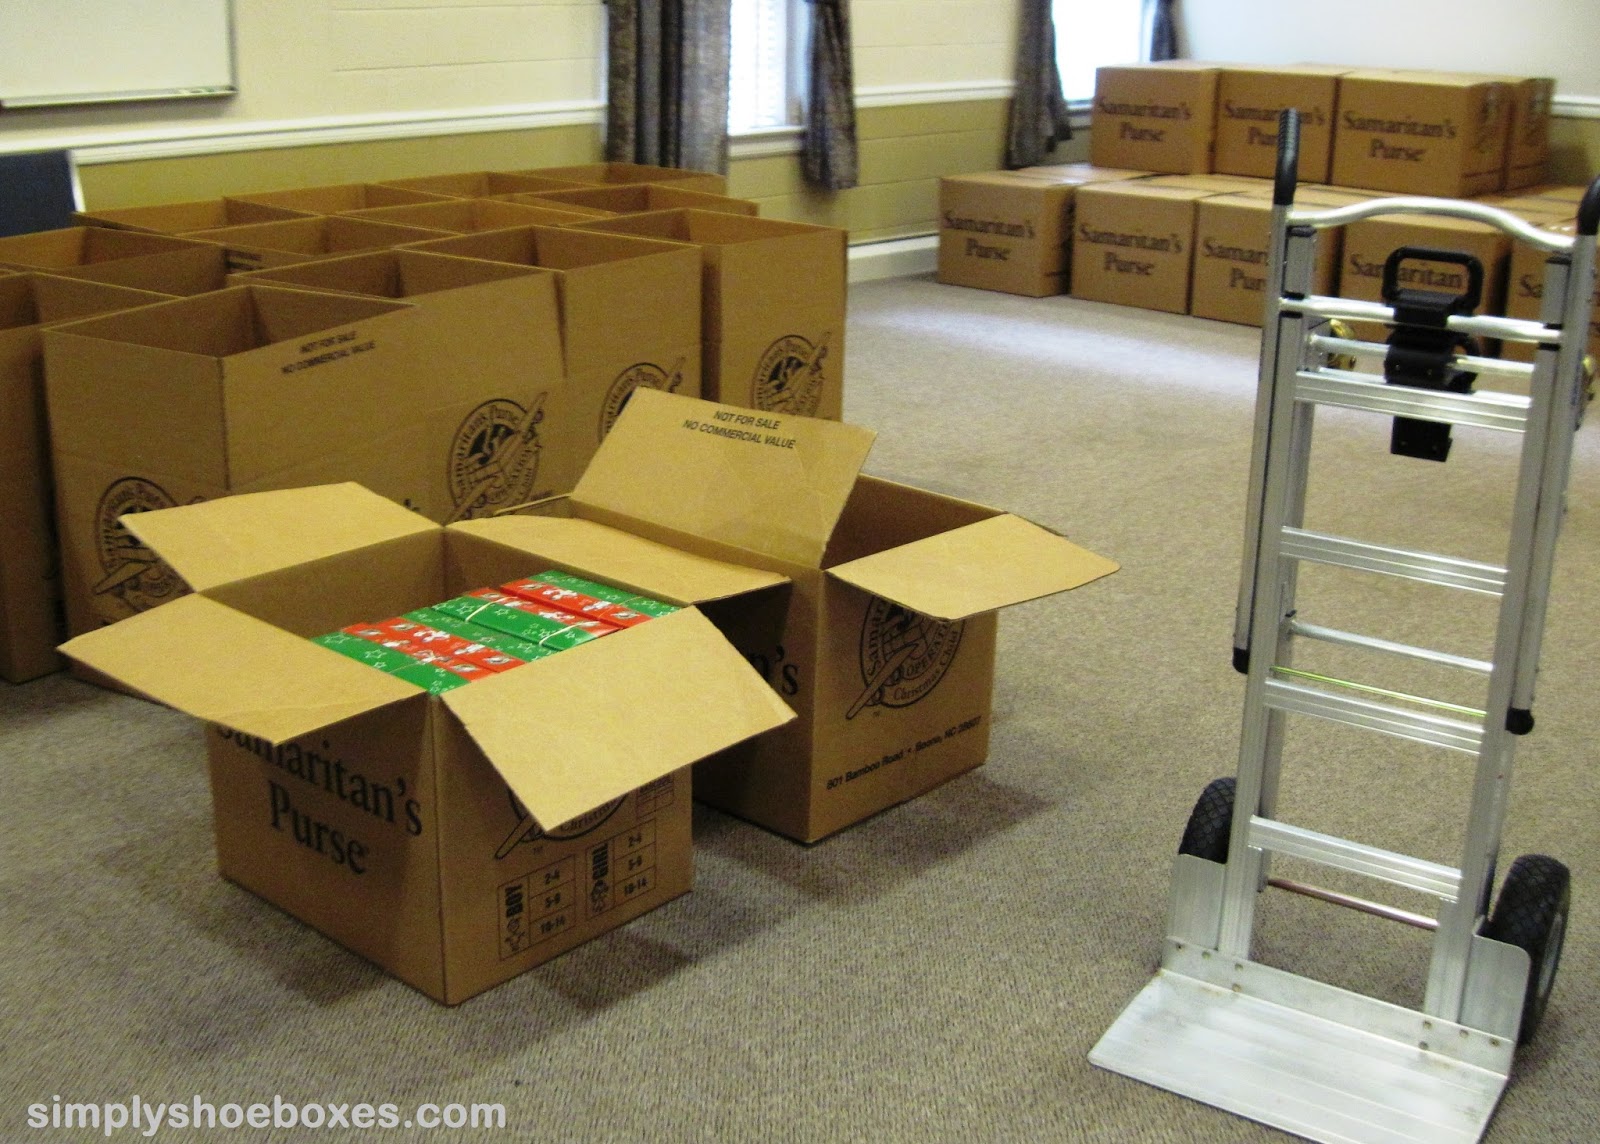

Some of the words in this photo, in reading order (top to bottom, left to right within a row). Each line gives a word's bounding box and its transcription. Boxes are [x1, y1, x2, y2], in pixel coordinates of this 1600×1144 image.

[1120, 121, 1165, 142] Purse
[1343, 110, 1457, 139] Samaritan's
[1369, 138, 1426, 162] Purse
[943, 210, 1036, 239] Samaritan's
[1080, 222, 1183, 254] Samaritan's
[965, 238, 1011, 261] Purse
[1105, 251, 1156, 276] Purse
[682, 419, 699, 430] NO
[699, 423, 762, 444] COMMERCIAL
[764, 435, 797, 449] VALUE
[713, 410, 736, 422] NOT
[736, 414, 756, 426] FOR
[755, 417, 782, 430] SALE
[825, 775, 843, 790] 801
[845, 761, 881, 783] Bamboo
[881, 750, 905, 766] Road
[944, 726, 957, 739] NC
[217, 726, 423, 836] amaritan's
[268, 779, 367, 875] Purse
[592, 842, 609, 881] GIRL
[505, 884, 523, 919] BOY
